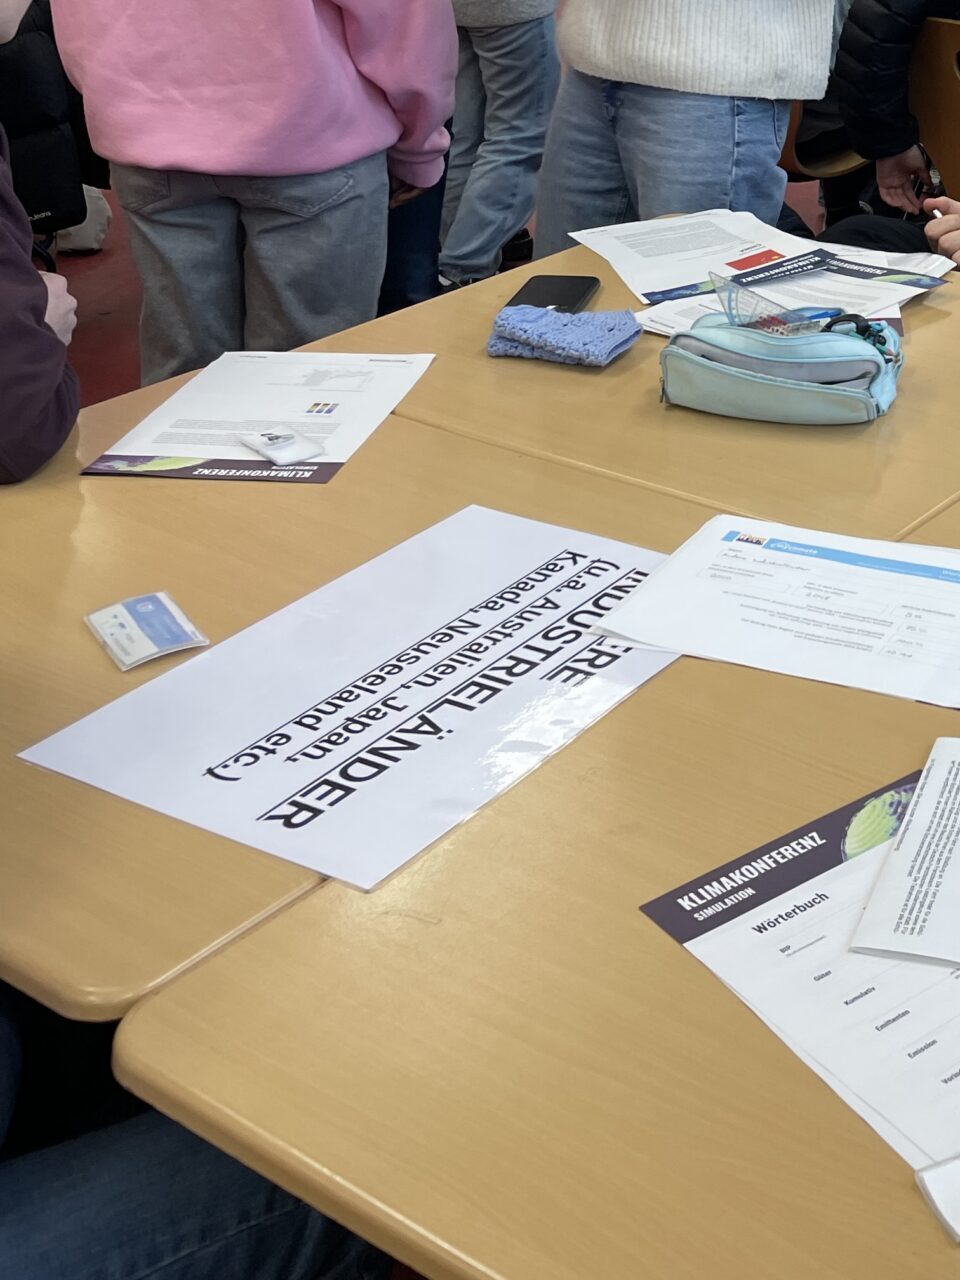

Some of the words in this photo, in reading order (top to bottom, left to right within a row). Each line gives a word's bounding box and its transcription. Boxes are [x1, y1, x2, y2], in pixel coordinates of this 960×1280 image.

[192, 466, 312, 478] KLIMAKONFERENZ
[471, 551, 587, 614] Kanada,
[556, 558, 621, 593] (u.a.
[401, 596, 562, 691] Australien,
[293, 617, 482, 734] Neuseeland
[265, 570, 650, 829] INDUSTRIELÄNDER
[284, 688, 410, 762] Japan,
[203, 732, 293, 782] etc.)
[677, 831, 827, 911] KLIMAKONFERENZ
[693, 887, 756, 921] SIMULATION
[752, 891, 829, 934] Wörterbuch
[813, 969, 832, 982] Güter
[843, 985, 876, 1006] Kumulativ
[874, 1009, 910, 1032] Emittenten
[907, 1039, 938, 1060] Emission
